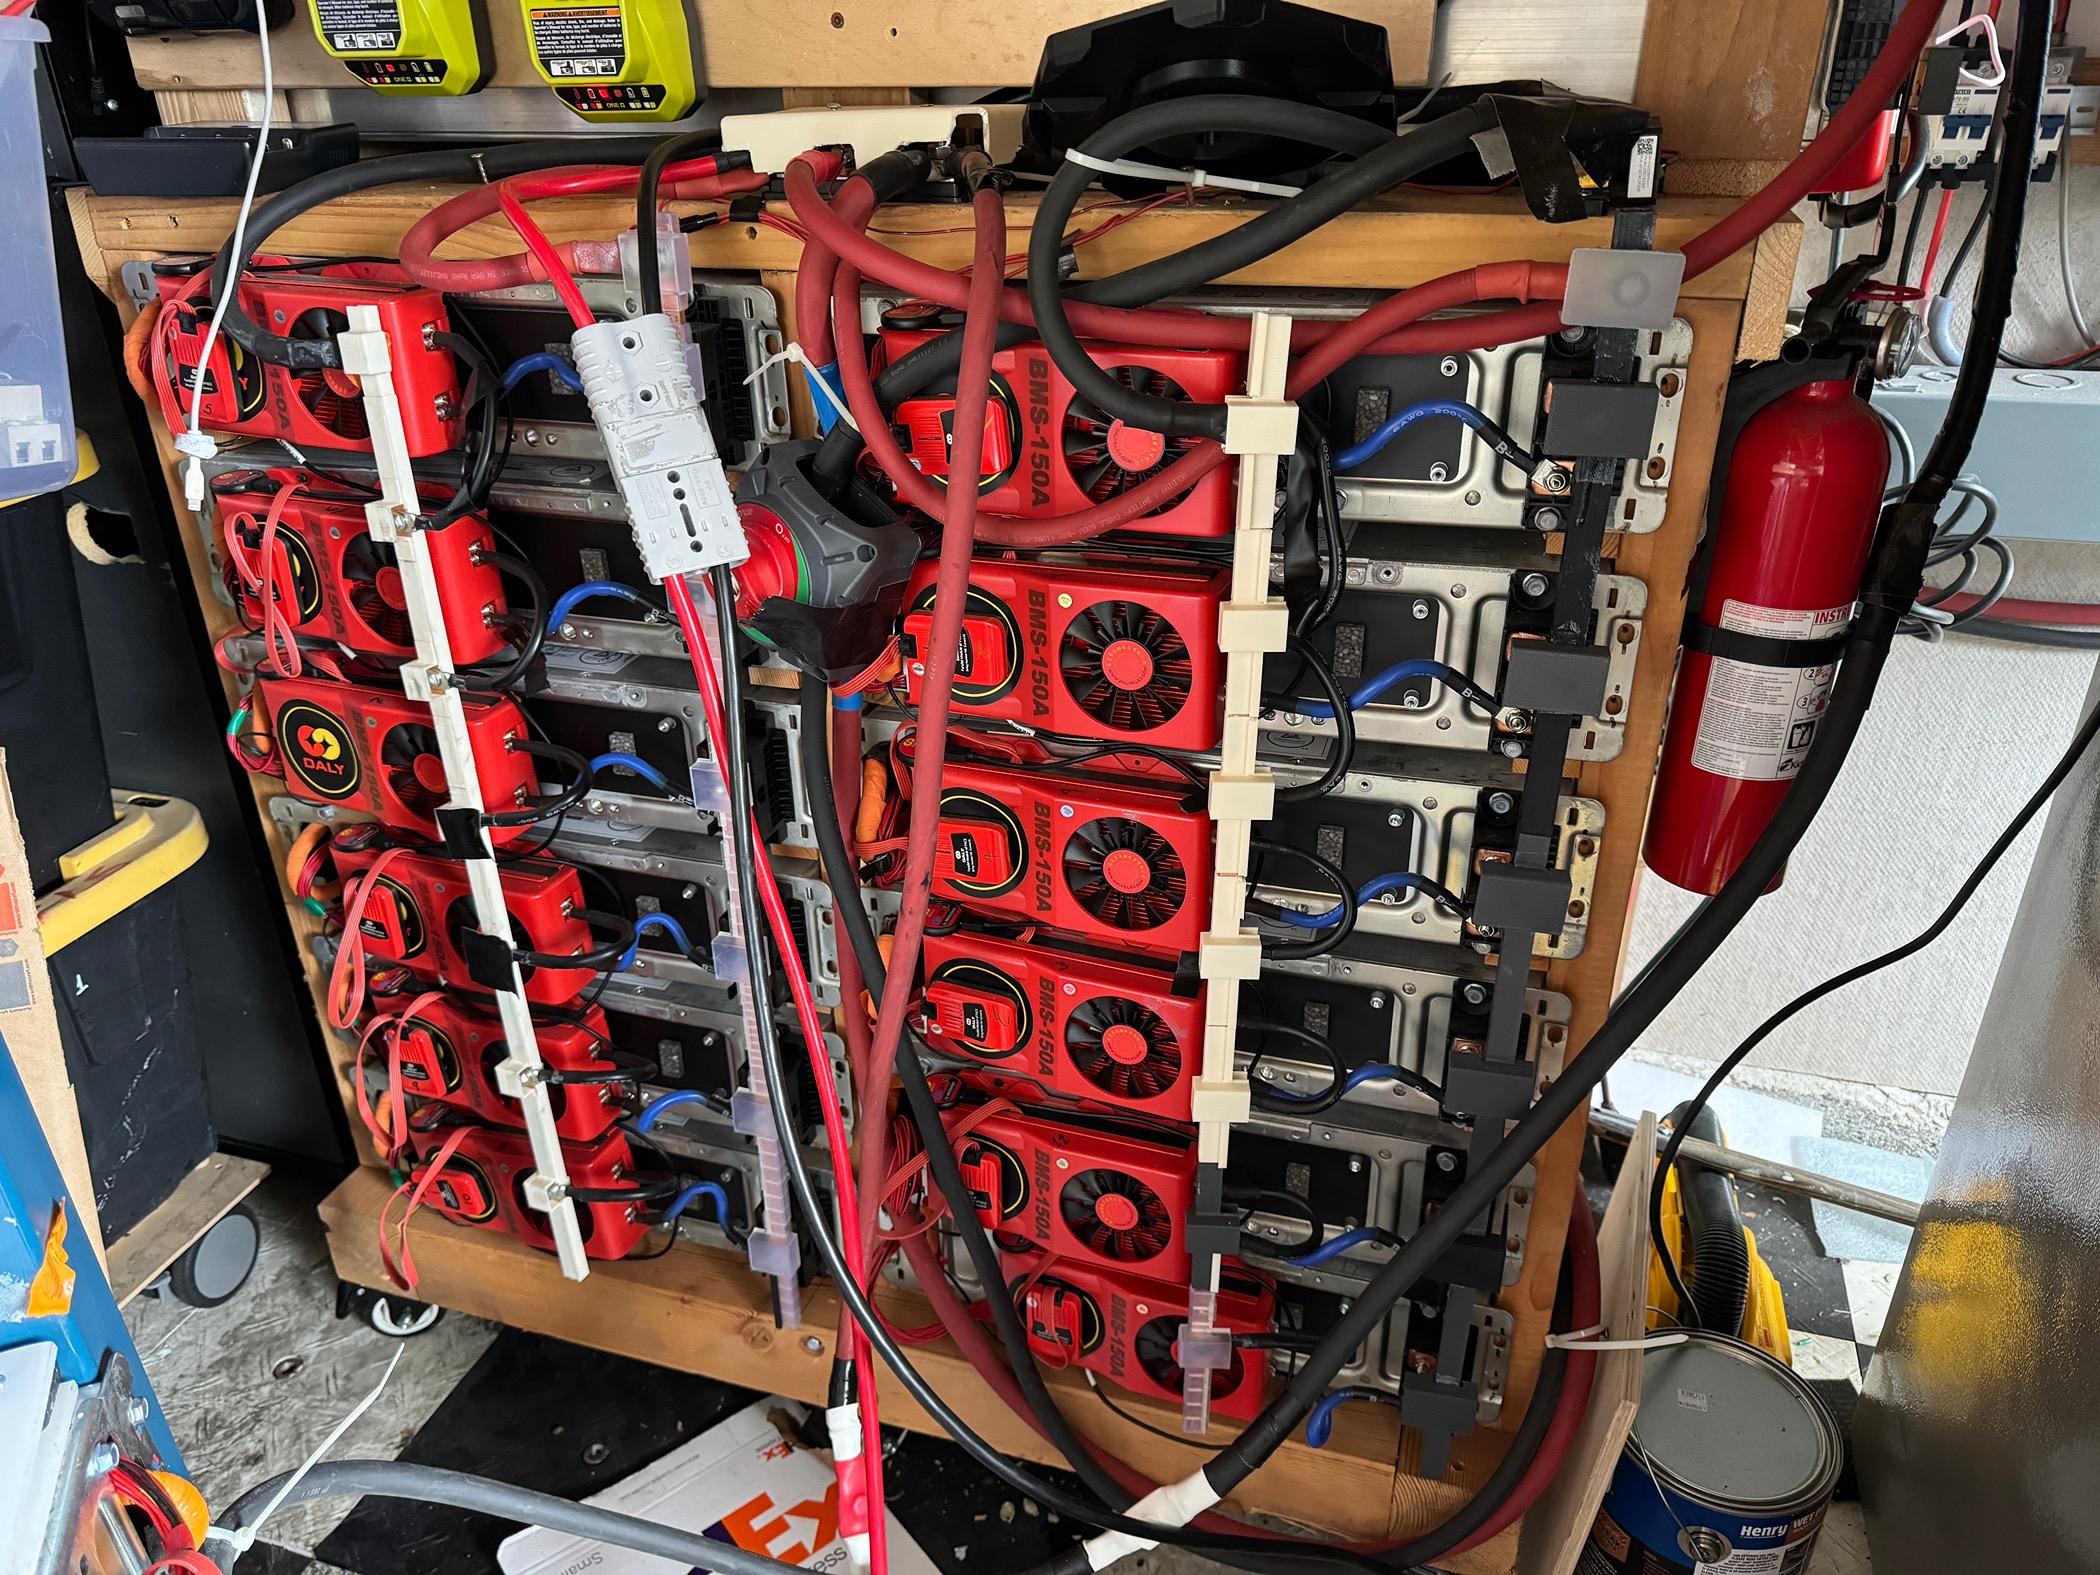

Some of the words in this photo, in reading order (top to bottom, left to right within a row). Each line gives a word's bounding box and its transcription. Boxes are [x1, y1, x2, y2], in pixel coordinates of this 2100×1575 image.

[1029, 358, 1050, 507] BMS-150A
[1028, 589, 1050, 716] BMS-150A
[1808, 669, 1814, 678] 2
[1801, 697, 1807, 706] 3
[303, 757, 345, 775] DALY
[1034, 801, 1052, 911] BMS-150A
[1039, 976, 1056, 1076] BMS-150A
[1034, 1148, 1050, 1240] BMS-150A
[1110, 1293, 1126, 1378] BMS-150A
[1740, 1524, 1788, 1538] Henry
